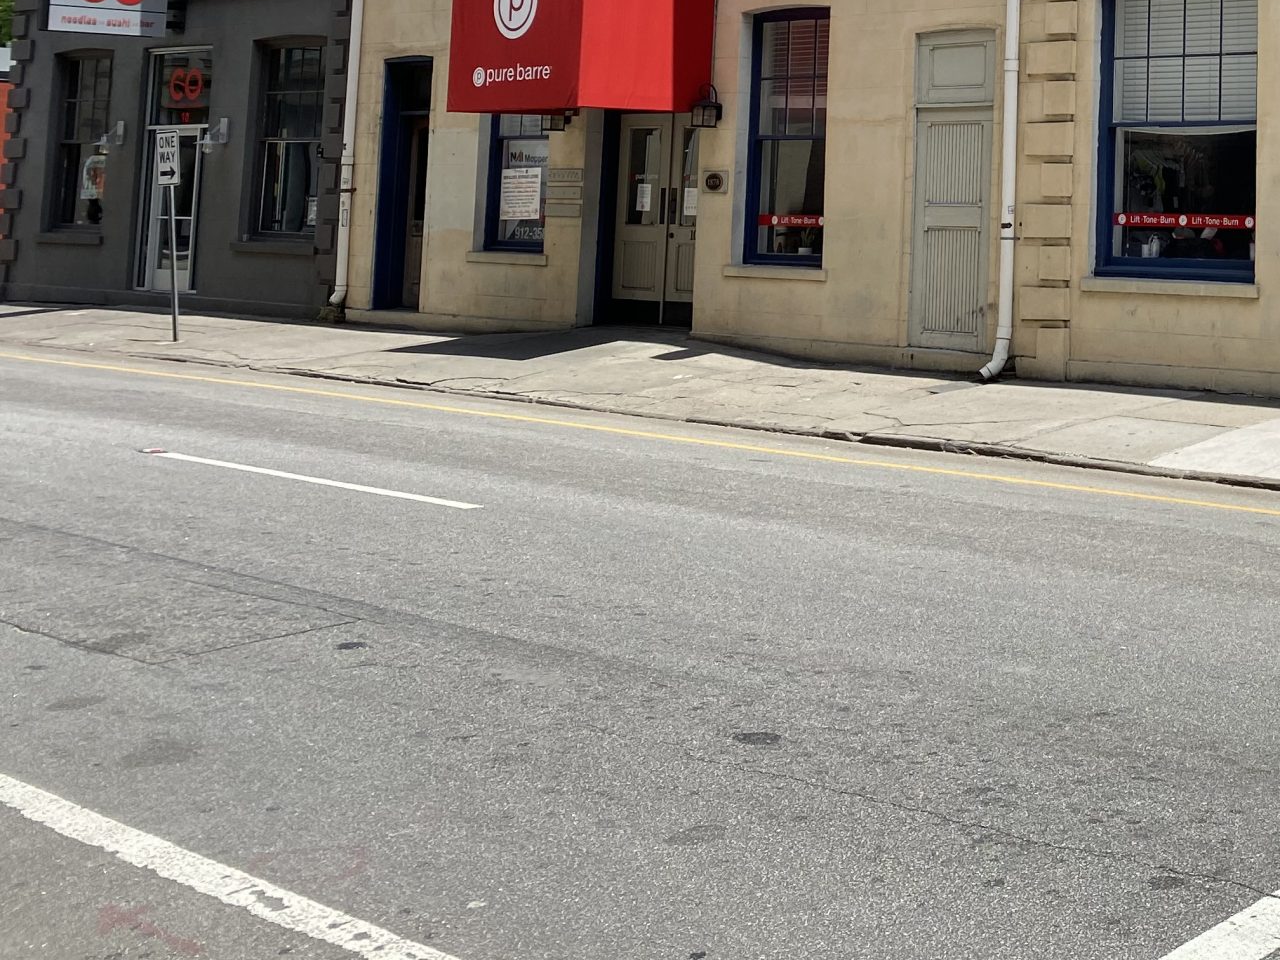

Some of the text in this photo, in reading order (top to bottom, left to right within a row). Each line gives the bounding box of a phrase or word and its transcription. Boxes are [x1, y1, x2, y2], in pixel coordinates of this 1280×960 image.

[486, 67, 514, 86] pure
[516, 63, 551, 81] barre
[160, 135, 176, 149] ONE
[159, 150, 176, 164] WAY
